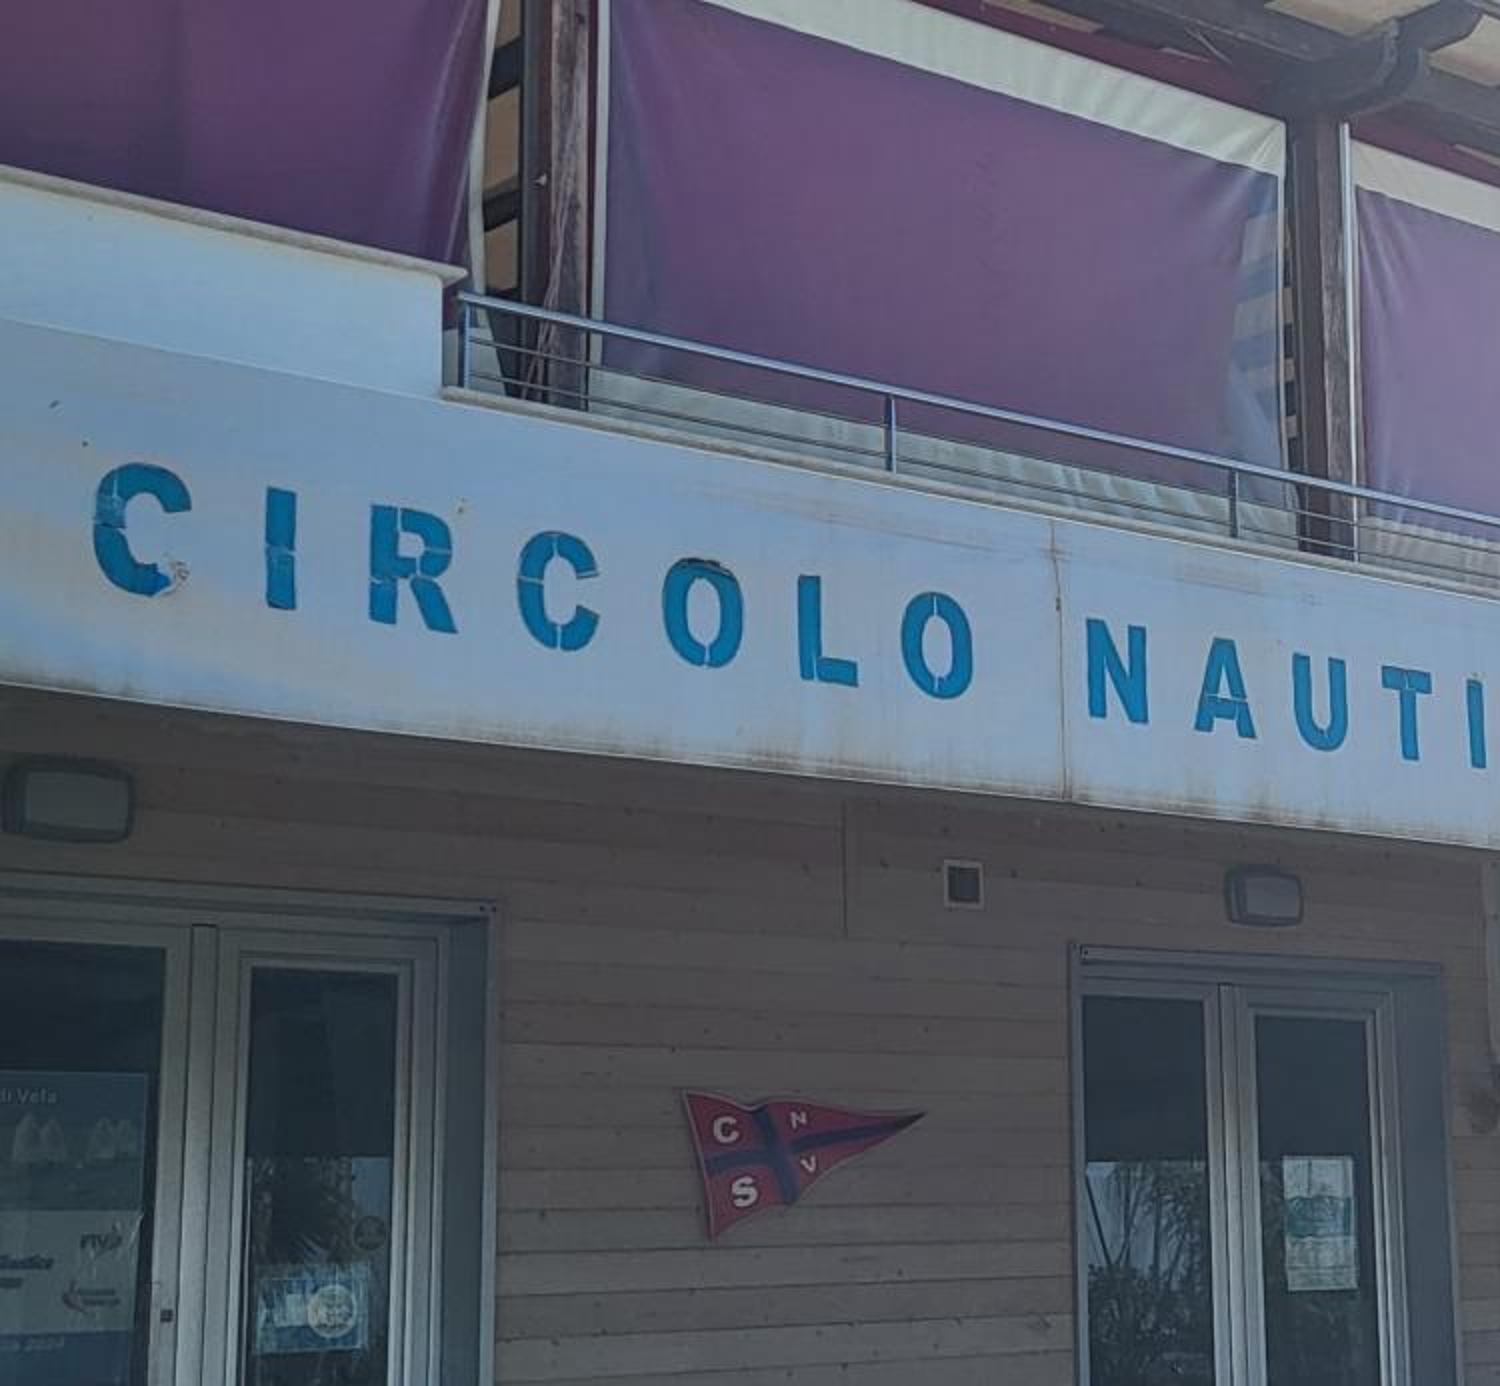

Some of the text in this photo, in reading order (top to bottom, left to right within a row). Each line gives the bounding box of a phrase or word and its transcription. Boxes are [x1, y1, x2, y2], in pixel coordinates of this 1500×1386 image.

[93, 463, 977, 701] CIRCOLO
[713, 1111, 807, 1144] C N
[731, 1156, 817, 1208] S V
